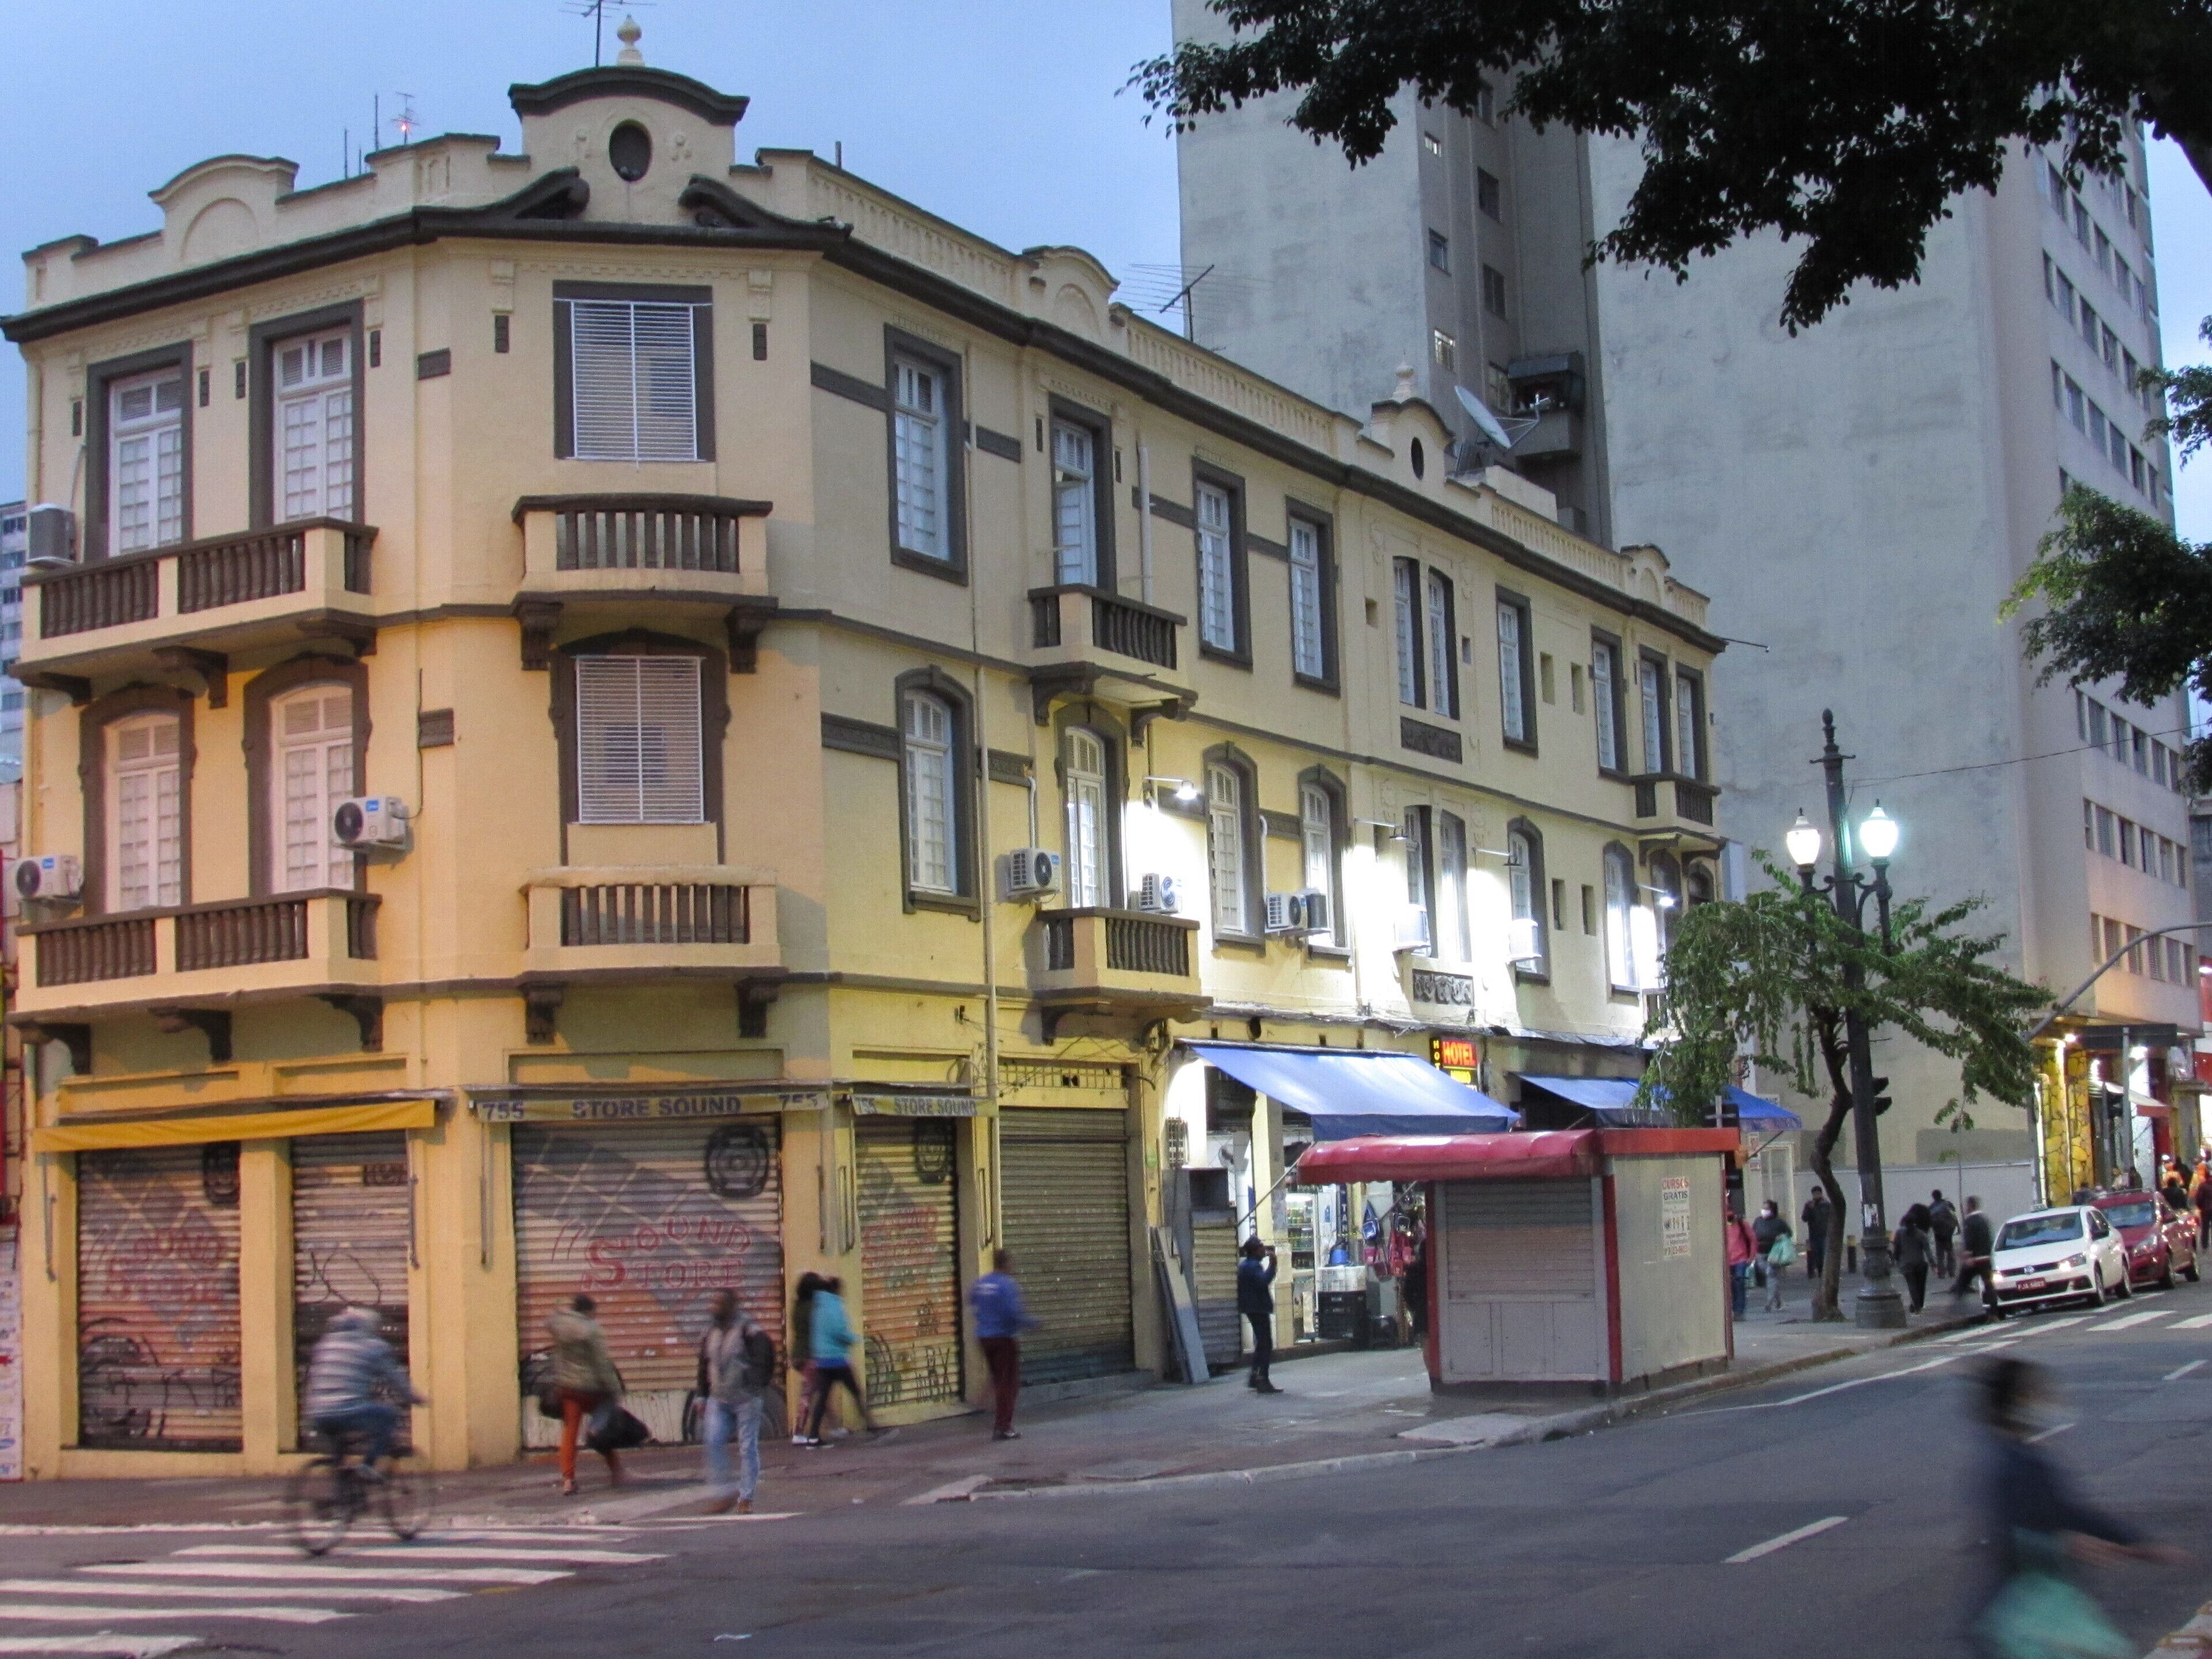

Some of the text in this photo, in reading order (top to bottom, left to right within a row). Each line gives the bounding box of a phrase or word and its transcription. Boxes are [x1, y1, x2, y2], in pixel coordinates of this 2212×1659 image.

[1442, 1041, 1476, 1065] HOTEL
[483, 1101, 524, 1120] 755
[571, 1099, 649, 1118] STORE
[659, 1096, 741, 1115] SOUND
[895, 1097, 933, 1116] STORE
[937, 1098, 978, 1116] SOUND
[1663, 1191, 1688, 1200] GRATIS
